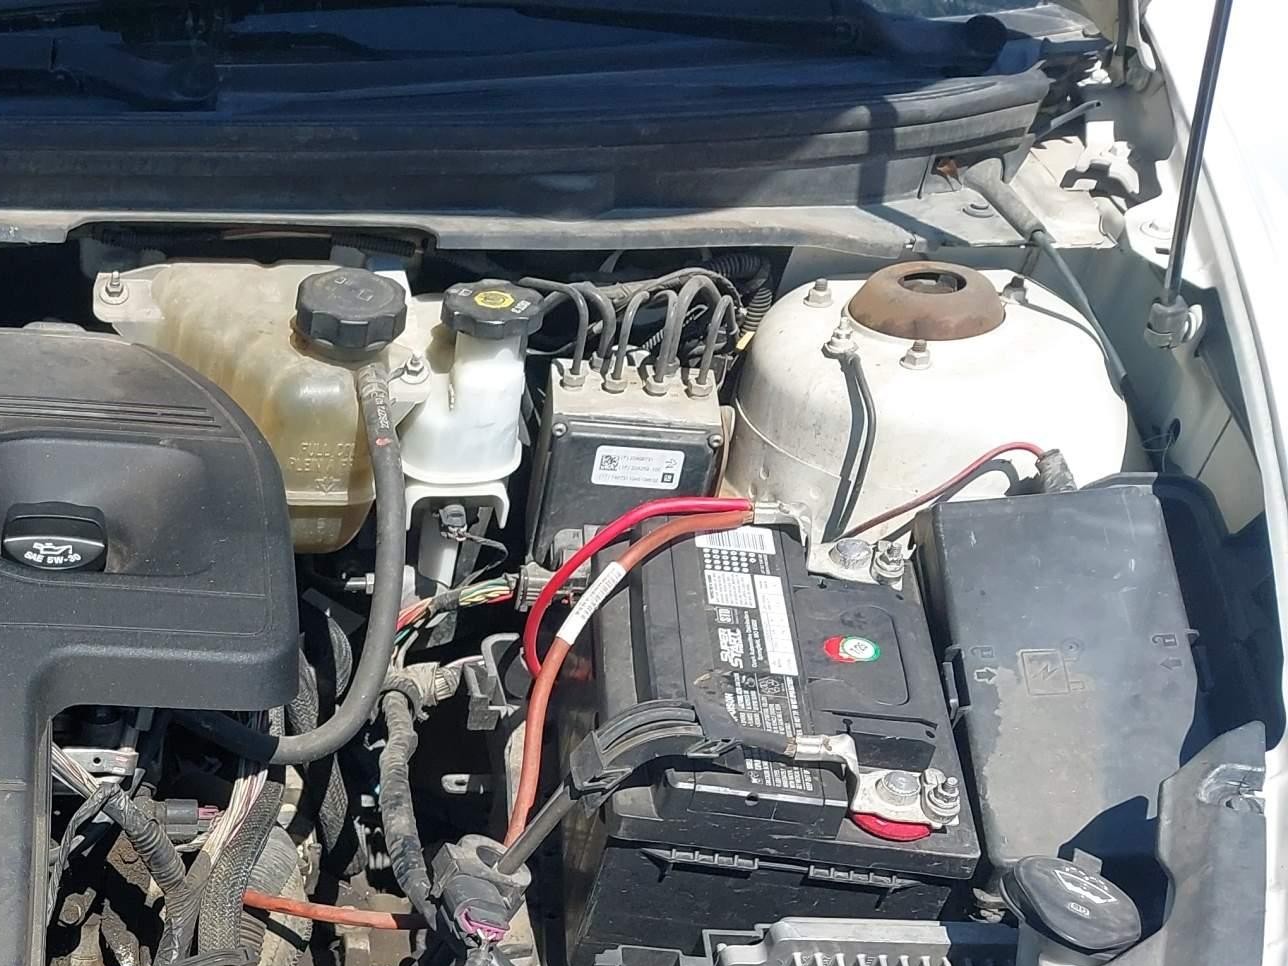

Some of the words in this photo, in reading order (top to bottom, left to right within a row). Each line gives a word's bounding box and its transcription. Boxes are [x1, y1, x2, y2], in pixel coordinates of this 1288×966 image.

[24, 550, 45, 564] SAE
[46, 553, 82, 564] 5W-30
[717, 627, 731, 662] SUPER
[729, 627, 744, 669] START
